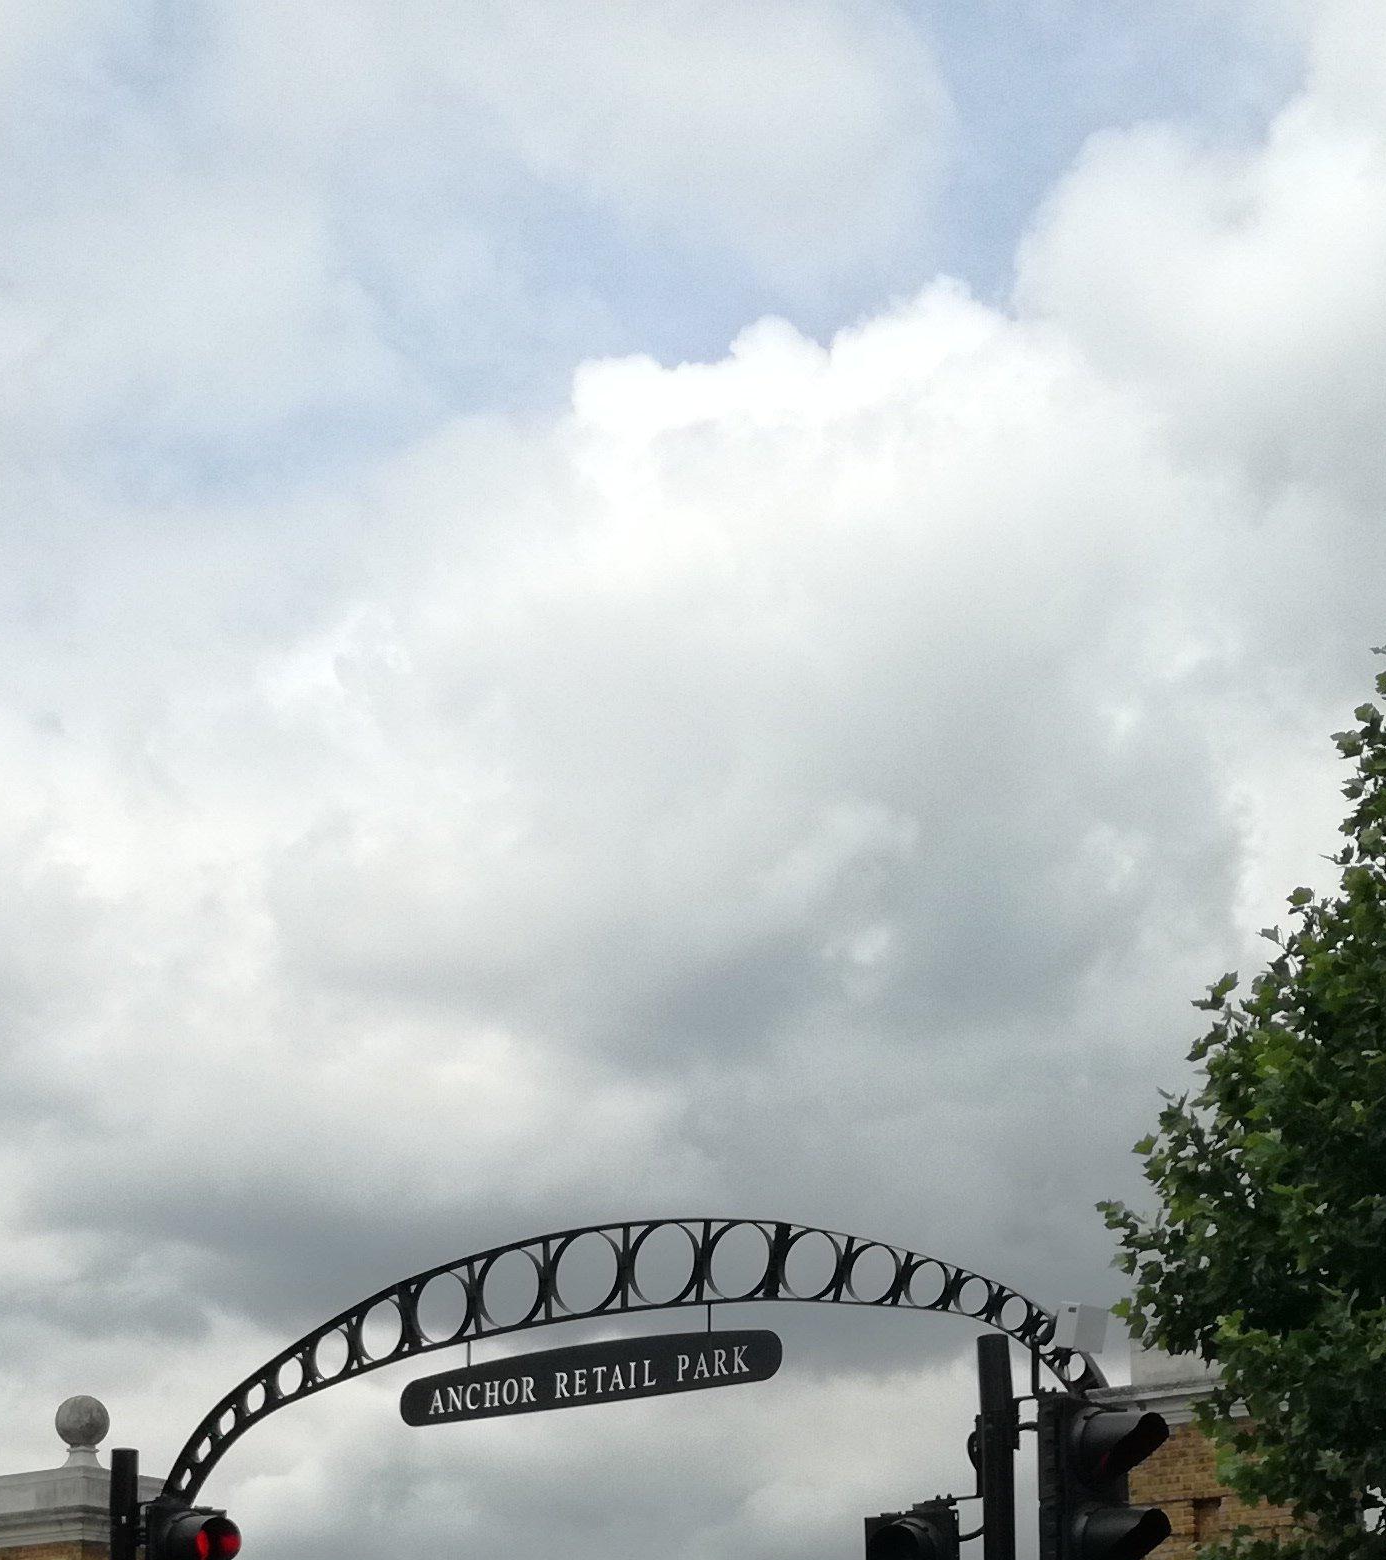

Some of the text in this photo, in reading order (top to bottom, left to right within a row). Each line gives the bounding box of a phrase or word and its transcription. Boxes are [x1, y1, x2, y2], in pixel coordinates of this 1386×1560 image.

[428, 1345, 751, 1415] ANCHOR RETAIL PARK
